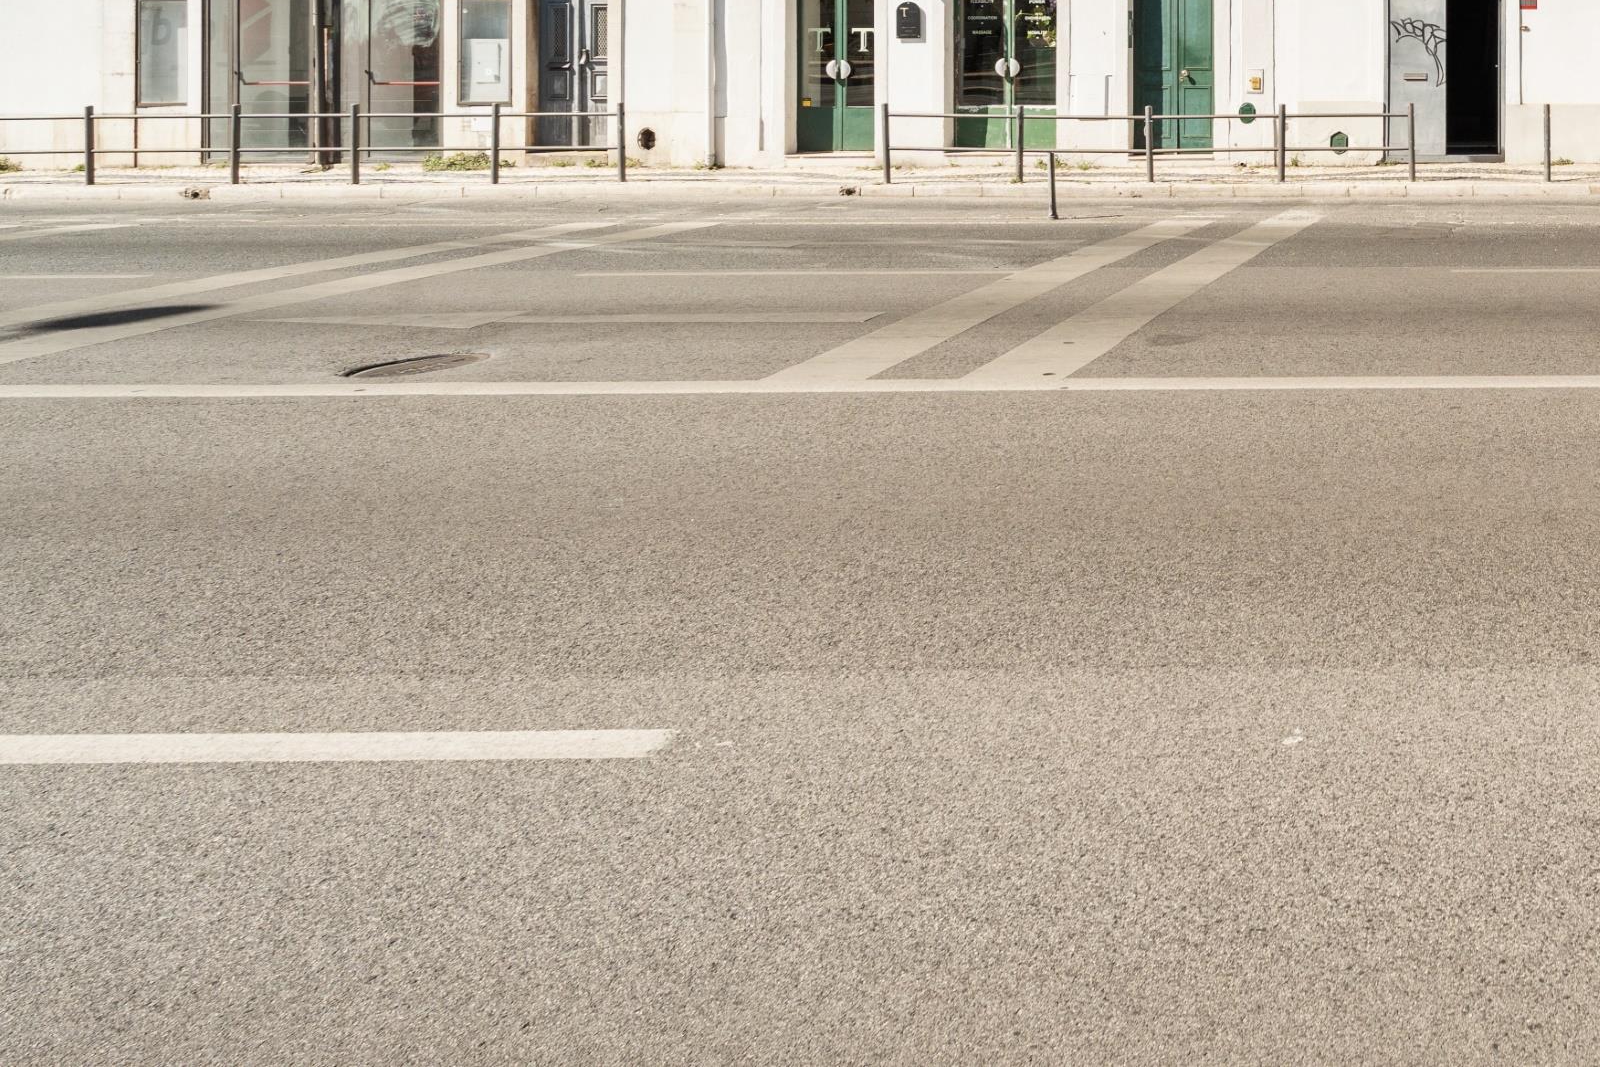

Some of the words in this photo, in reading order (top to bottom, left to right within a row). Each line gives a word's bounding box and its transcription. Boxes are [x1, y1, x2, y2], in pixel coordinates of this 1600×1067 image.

[899, 7, 909, 18] T
[807, 27, 832, 52] T
[851, 27, 874, 52] T
